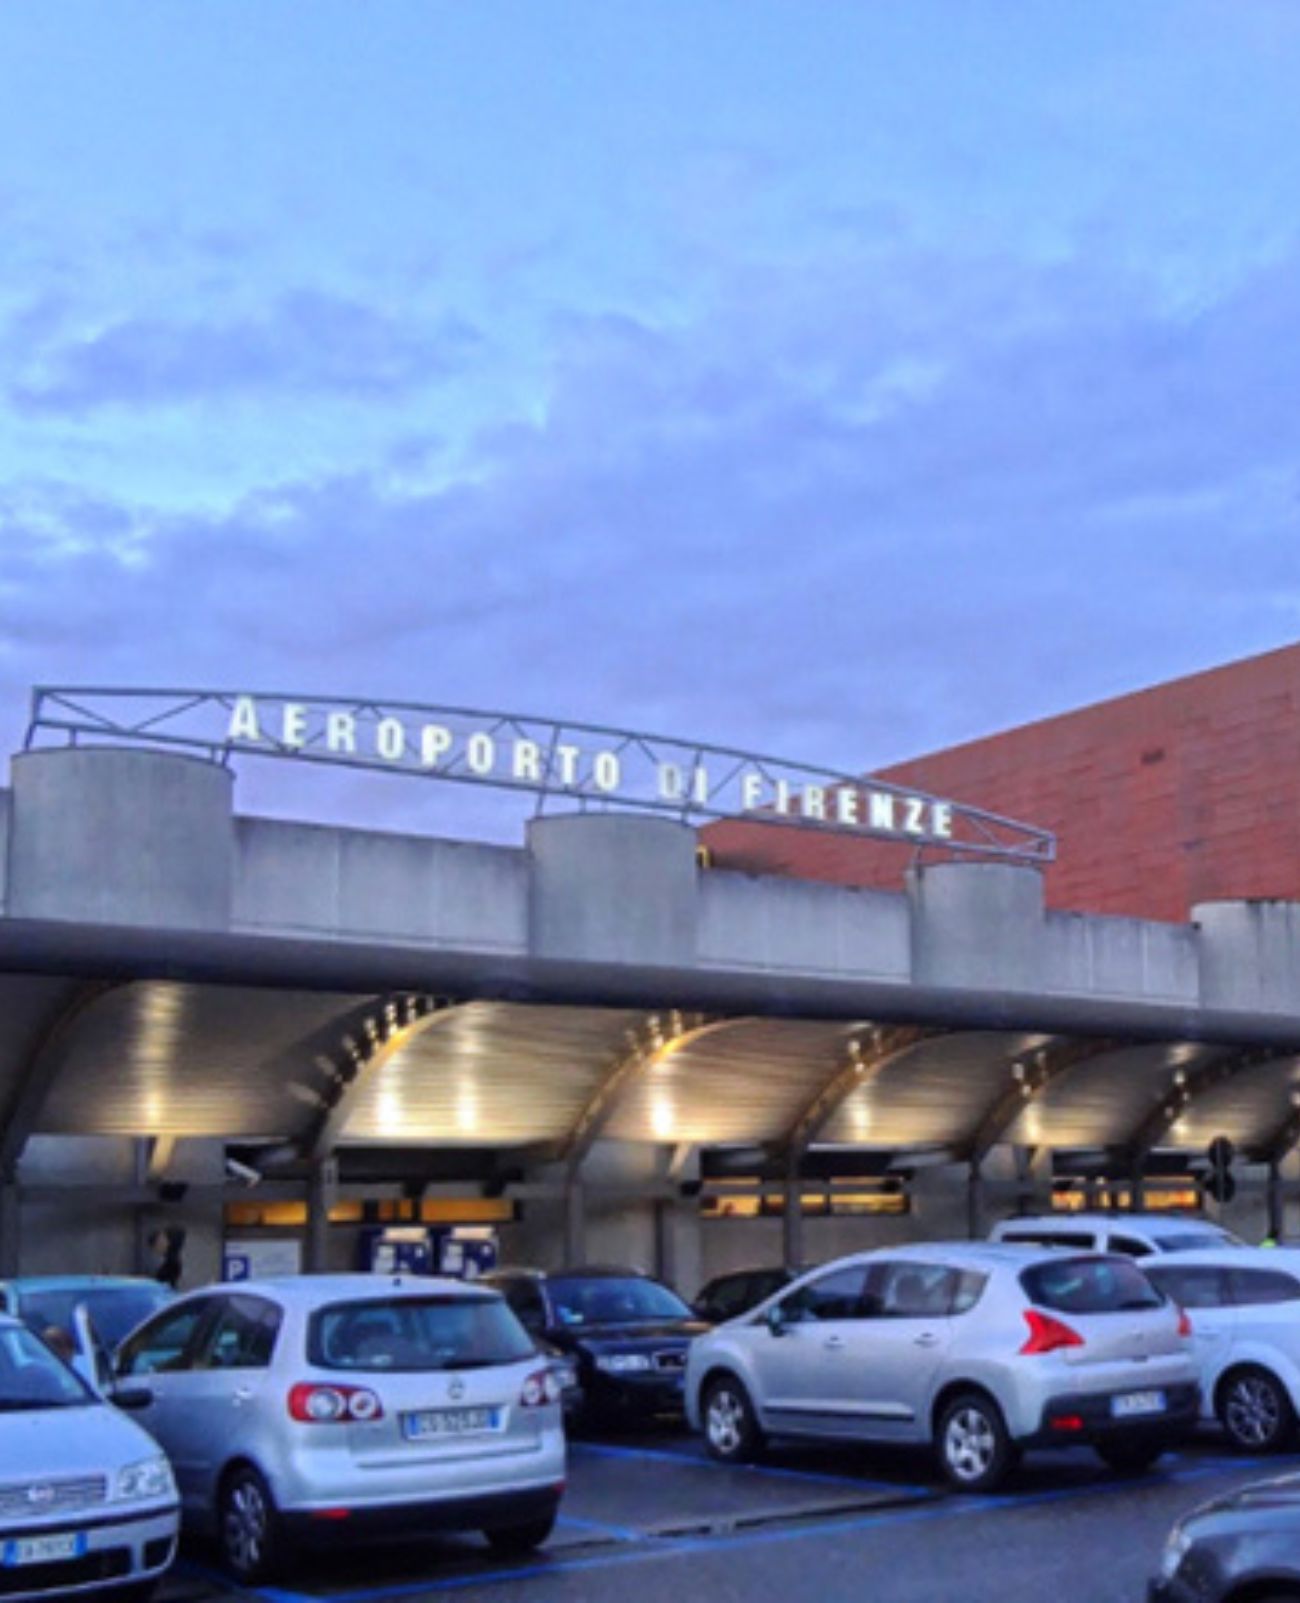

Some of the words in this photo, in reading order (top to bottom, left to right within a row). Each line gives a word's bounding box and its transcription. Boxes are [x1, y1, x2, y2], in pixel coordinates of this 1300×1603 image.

[229, 696, 620, 791] AEROPORTO
[658, 762, 708, 809] DI
[742, 774, 952, 837] FIRENZE
[227, 1258, 244, 1280] P
